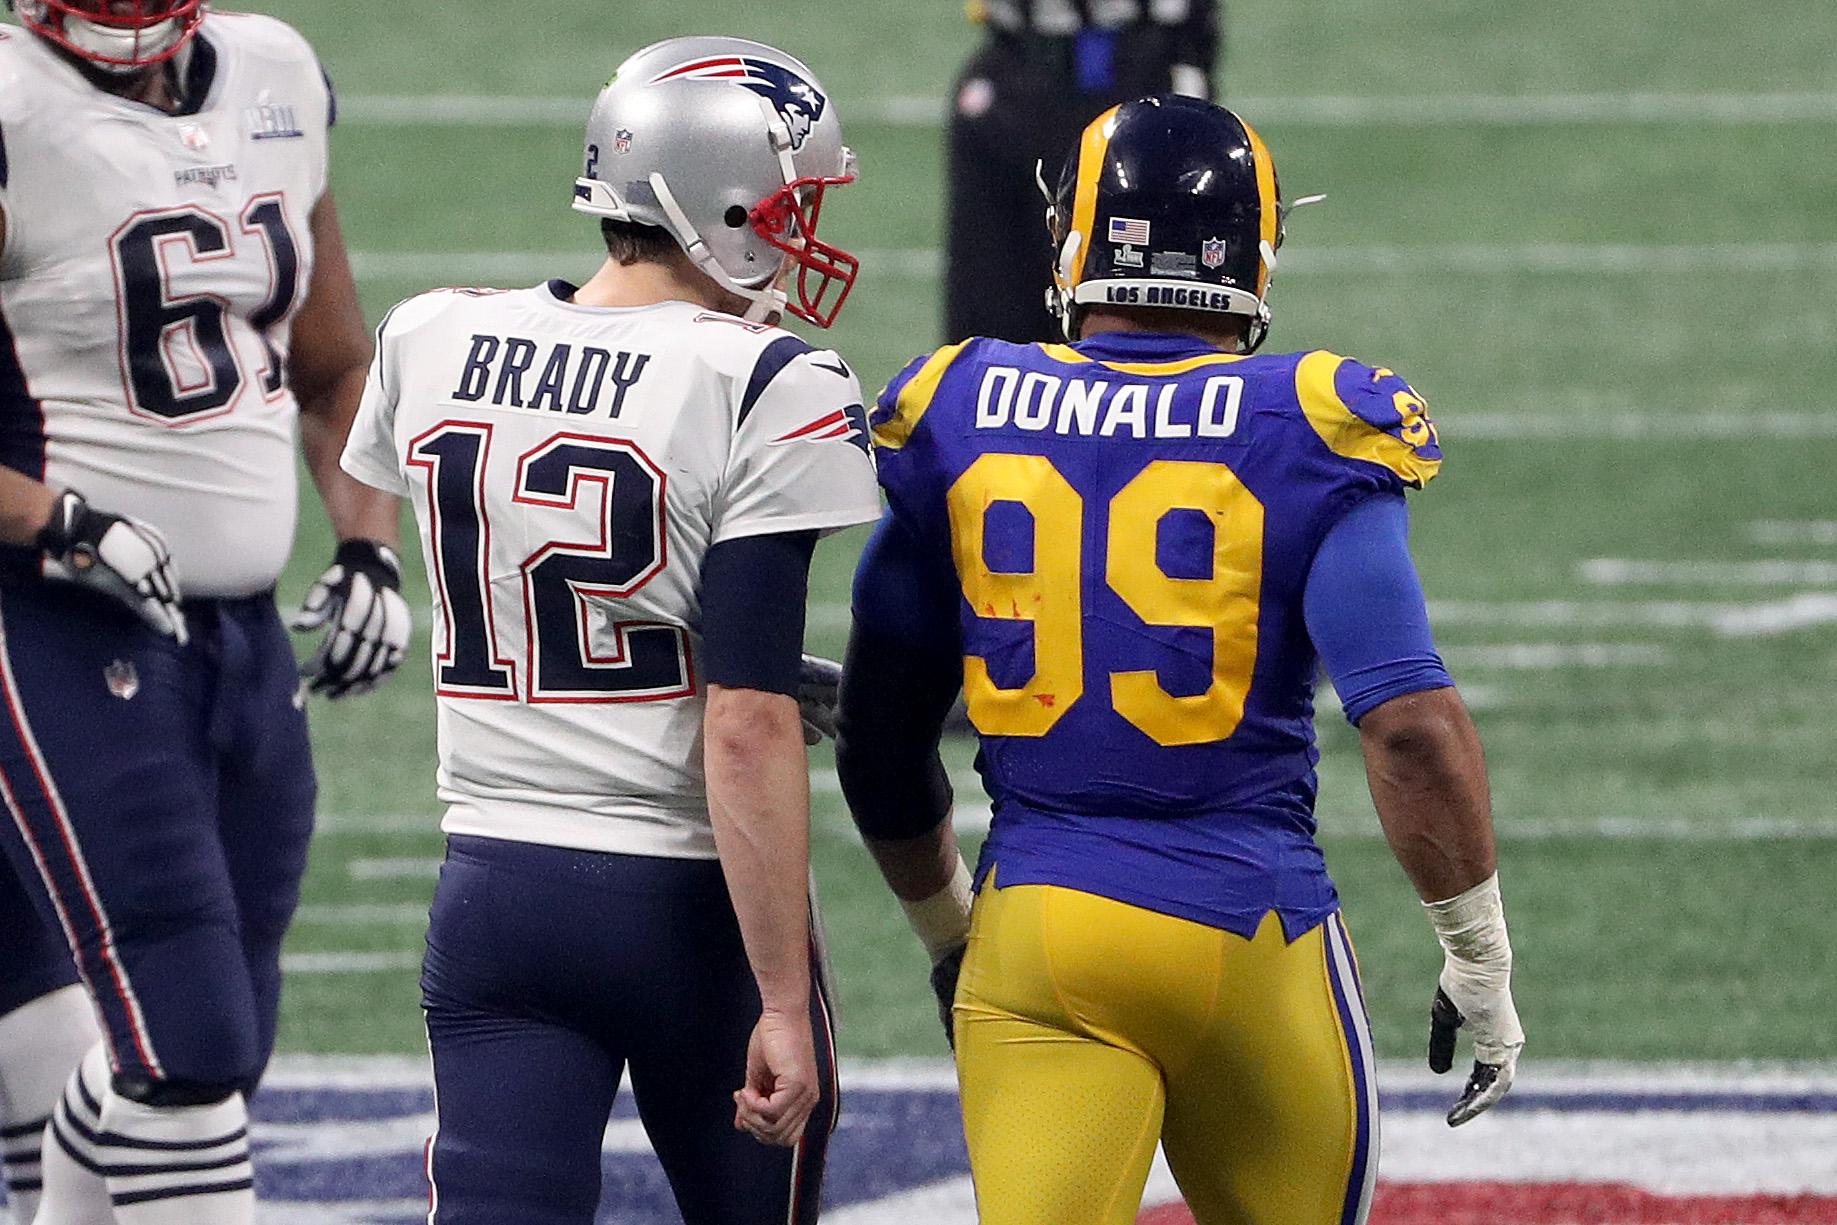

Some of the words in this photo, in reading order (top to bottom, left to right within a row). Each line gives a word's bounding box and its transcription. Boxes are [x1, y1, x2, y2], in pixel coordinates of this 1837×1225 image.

[109, 191, 299, 427] 61
[452, 333, 651, 420] BRADY
[1106, 286, 1139, 303] LOS
[1146, 286, 1231, 311] ANGELES
[975, 366, 1245, 438] DONALD
[406, 419, 697, 704] 12
[947, 452, 1265, 747] 99
